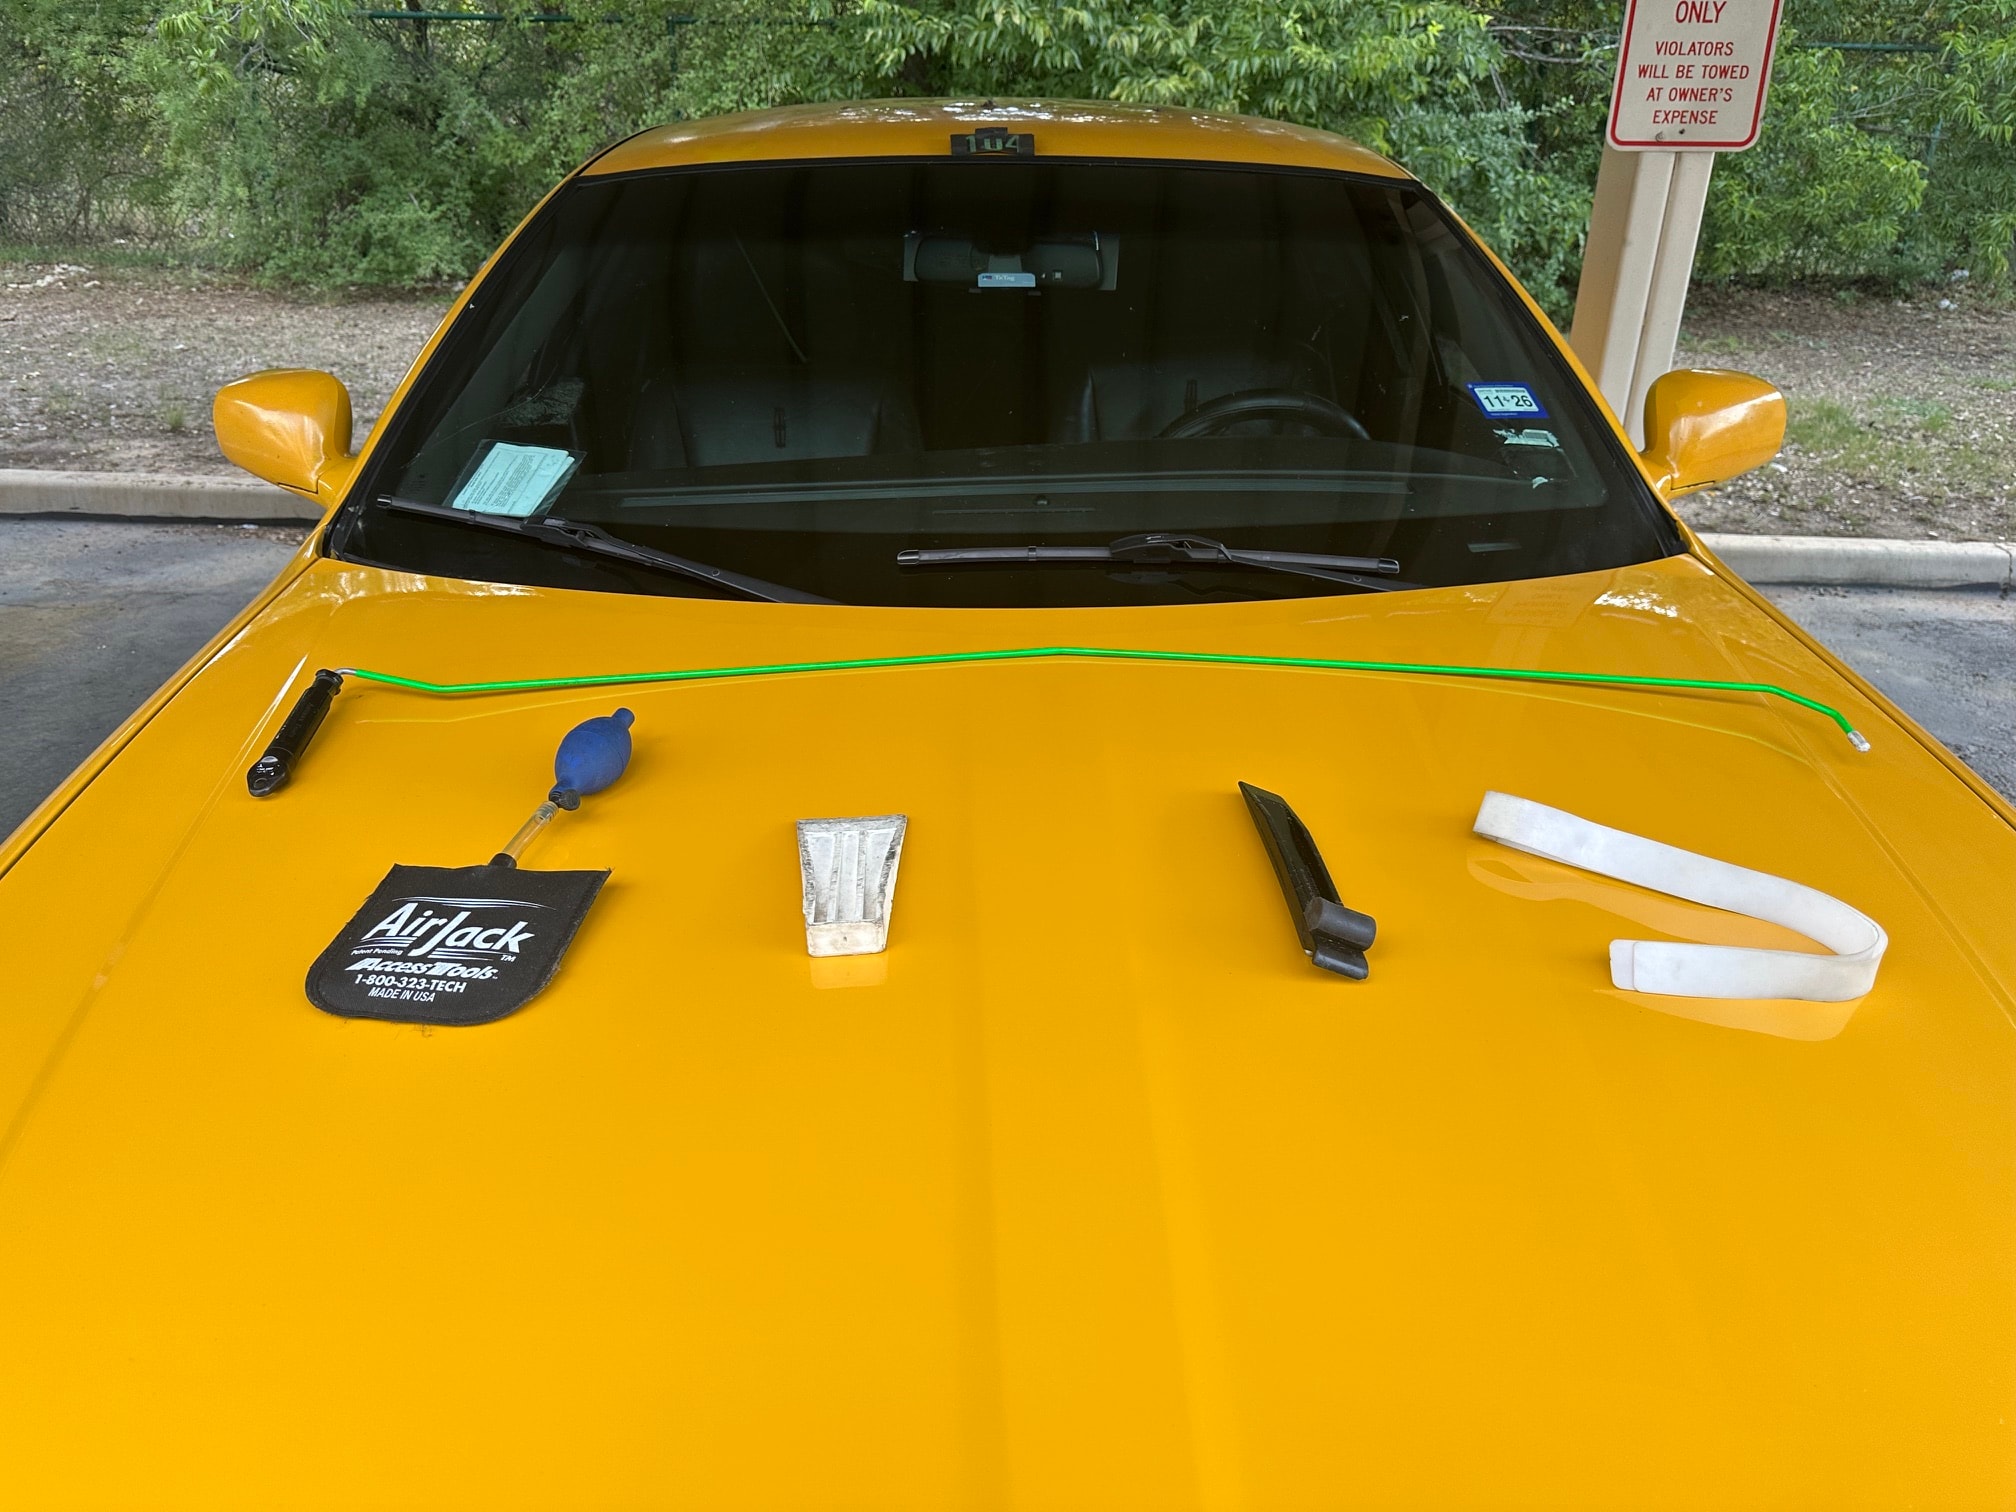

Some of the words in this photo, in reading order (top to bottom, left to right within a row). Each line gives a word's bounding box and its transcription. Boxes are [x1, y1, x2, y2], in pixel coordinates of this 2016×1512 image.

[1675, 1, 1727, 24] ONLY
[1655, 41, 1734, 56] VIOLATORS
[1638, 64, 1669, 79] WILL
[1675, 64, 1694, 79] BE
[1702, 64, 1749, 79] TOWED
[1646, 88, 1663, 101] AT
[1668, 87, 1733, 102] OWNER'S
[1652, 110, 1718, 125] EXPENSE
[1484, 395, 1504, 408] 11
[1510, 395, 1533, 408] 26
[351, 948, 372, 956] Patent
[373, 948, 404, 956] Pending
[501, 954, 516, 962] TM
[354, 973, 467, 993] 1-800-323-TECH
[368, 986, 399, 1000] MADE
[399, 989, 414, 1000] IN
[414, 990, 437, 1003] USA
